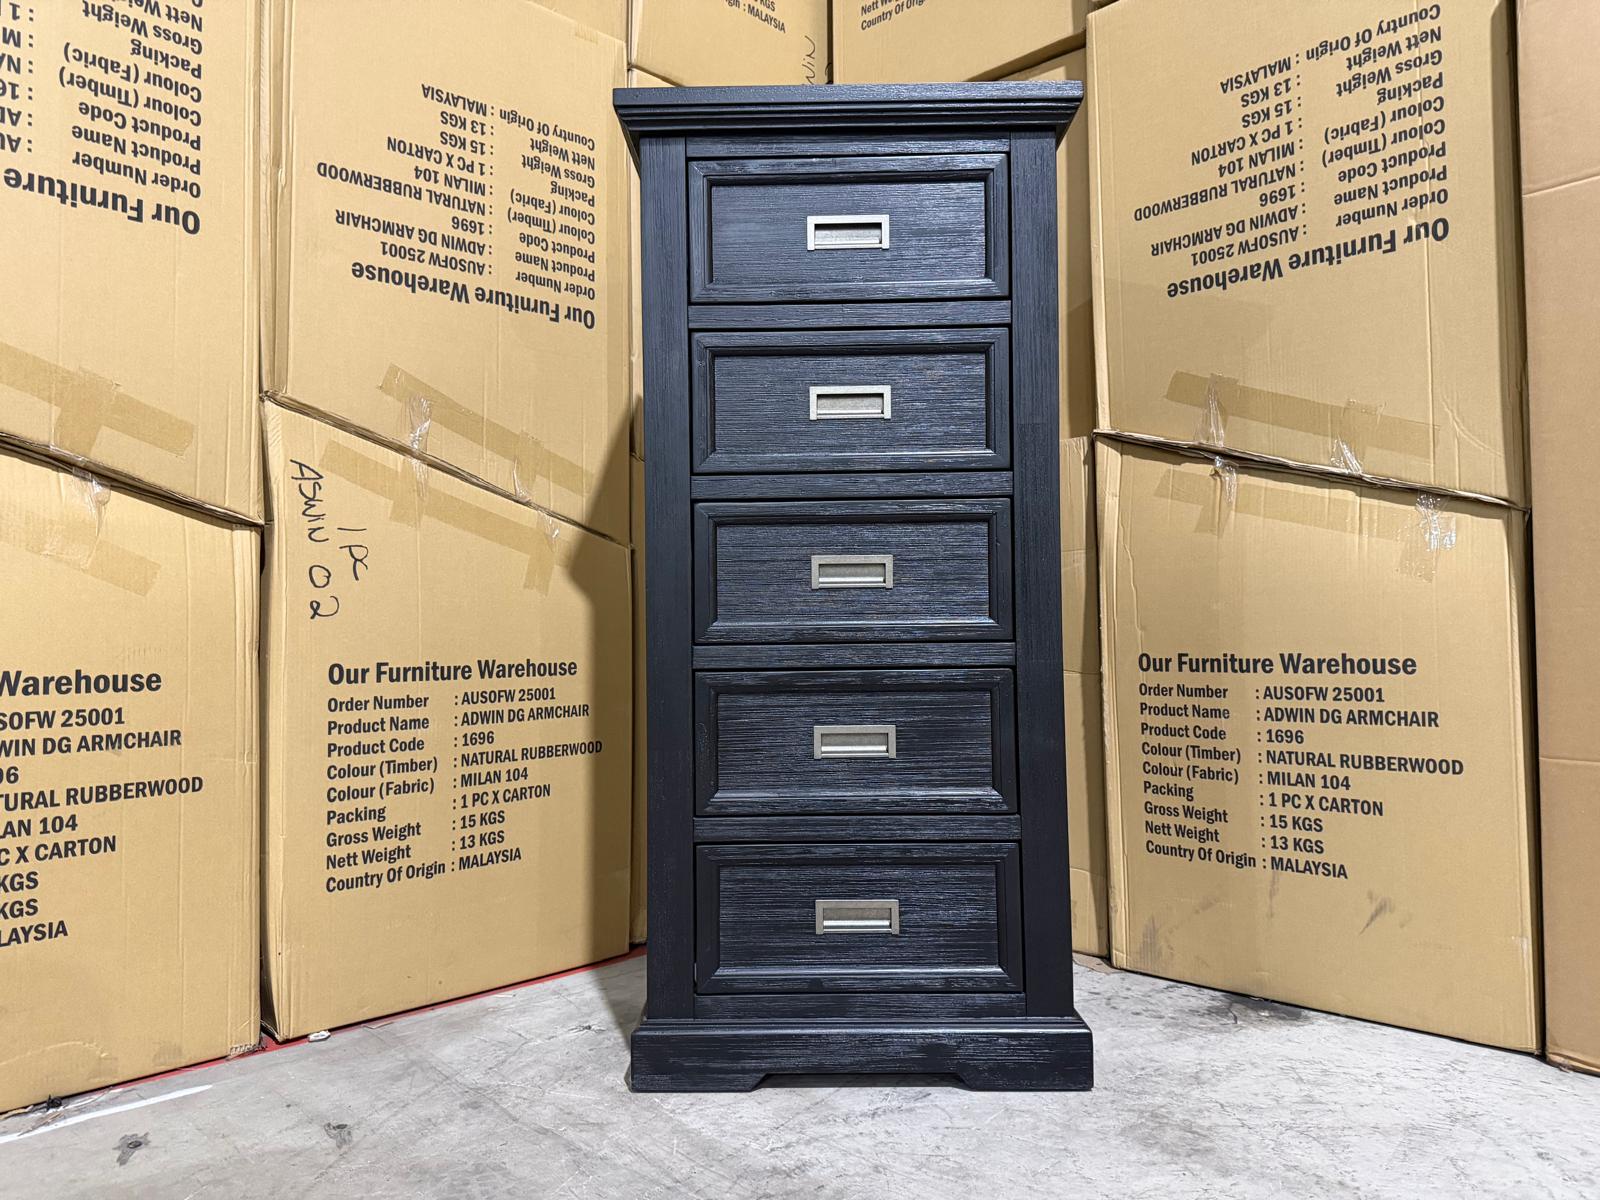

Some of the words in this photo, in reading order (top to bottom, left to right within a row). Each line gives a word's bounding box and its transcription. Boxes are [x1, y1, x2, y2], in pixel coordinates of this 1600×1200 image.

[82, 0, 149, 39] Weight
[164, 4, 203, 33] Nett
[746, 3, 786, 34] MALAYSIA
[860, 8, 893, 31] Country
[152, 24, 203, 56] Gross
[63, 41, 140, 85] (Fabric)
[129, 38, 202, 80] Packing
[58, 65, 140, 109] (Timber)
[143, 71, 202, 104] Colour
[78, 101, 127, 130] Code
[143, 95, 202, 127] Colour
[1389, 95, 1445, 123] Colour
[71, 125, 127, 156] Name
[131, 116, 201, 152] Product
[1324, 110, 1386, 145] (Fabric)
[1390, 118, 1446, 145] Colour
[130, 140, 201, 176] Product
[1248, 141, 1295, 169] MILAN
[1321, 132, 1387, 169] (Timber)
[1380, 140, 1447, 174] Product
[71, 151, 147, 186] Number
[316, 161, 423, 201] RUBBERWOOD
[413, 165, 440, 185] 104
[1217, 156, 1245, 178] 104
[1230, 162, 1296, 194] NATURAL
[1337, 162, 1378, 184] Code
[1381, 164, 1448, 196] Product
[3, 167, 144, 224] Furniture
[151, 172, 201, 199] Order
[443, 172, 486, 197] MILAN
[1258, 184, 1296, 208] 1696
[1333, 183, 1379, 206] Name
[425, 188, 486, 217] NATURAL
[510, 188, 557, 216] (Fabric)
[558, 204, 596, 226] Colour
[1133, 182, 1228, 222] RUBBERWOOD
[1335, 200, 1398, 228] Number
[1401, 188, 1449, 218] Order
[151, 202, 201, 235] Our
[335, 209, 416, 240] ARMCHAIR
[451, 215, 485, 236] 1696
[507, 206, 557, 235] (Timber)
[1225, 219, 1246, 237] DG
[1249, 204, 1299, 232] ADWIN
[1403, 217, 1450, 248] Our
[417, 227, 438, 247] DG
[441, 233, 486, 257] ADWIN
[518, 232, 549, 253] Code
[558, 223, 596, 245] Colour
[1150, 224, 1223, 257] ARMCHAIR
[1237, 225, 1300, 256] AUSOFW
[380, 240, 426, 264] 25001
[428, 251, 486, 277] AUSOFW
[514, 251, 549, 272] Name
[551, 240, 595, 264] Product
[1190, 242, 1235, 267] 25001
[1288, 229, 1397, 270] Furniture
[351, 261, 470, 305] Warehouse
[515, 271, 562, 294] Number
[551, 259, 596, 283] Product
[1166, 257, 1284, 298] Warehouse
[474, 286, 560, 324] Furniture
[563, 281, 596, 301] Order
[563, 305, 596, 330] Our
[328, 662, 370, 686] Our
[375, 660, 473, 684] Furniture
[476, 658, 578, 680] Warehouse
[1138, 652, 1173, 673] Our
[1177, 652, 1275, 674] Furniture
[1278, 652, 1417, 676] Warehouse
[327, 696, 371, 713] Order
[373, 693, 430, 711] Number
[460, 688, 516, 706] AUSOFW
[517, 686, 556, 703] 25001
[1138, 682, 1174, 697] Order
[1176, 683, 1229, 699] Number
[1262, 685, 1329, 702] AUSOFW
[1332, 686, 1385, 703] 25001
[60, 706, 126, 728] 25001
[327, 717, 387, 736] Product
[389, 715, 430, 732] Name
[460, 708, 505, 727] ADWIN
[507, 707, 525, 723] DG
[526, 703, 590, 722] ARMCHAIR
[1139, 701, 1190, 718] Product
[1191, 703, 1231, 720] Name
[1263, 706, 1316, 724] ADWIN
[1319, 708, 1343, 725] DG
[1345, 708, 1440, 728] ARMCHAIR
[42, 736, 72, 755] DG
[76, 729, 182, 753] ARMCHAIR
[327, 739, 386, 758] Product
[388, 736, 425, 753] Code
[461, 730, 495, 747] 1696
[1140, 721, 1191, 739] Product
[1192, 724, 1227, 741] Code
[1266, 728, 1305, 745] 1696
[326, 763, 377, 781] Colour
[379, 756, 438, 779] (Timber)
[460, 748, 519, 768] NATURAL
[520, 740, 603, 761] RUBBERWOOD
[1141, 741, 1183, 758] Colour
[1185, 744, 1242, 765] (Timber)
[1266, 749, 1337, 768] NATURAL
[1339, 753, 1464, 776] RUBBERWOOD
[326, 785, 377, 803] Colour
[378, 777, 435, 801] (Fabric)
[460, 769, 502, 788] MILAN
[505, 766, 529, 783] 104
[1142, 760, 1184, 778] Colour
[1186, 764, 1239, 786] (Fabric)
[1267, 770, 1316, 789] MILAN
[1320, 774, 1352, 791] 104
[65, 776, 204, 807] RUBBERWOOD
[326, 805, 387, 826] Packing
[471, 791, 490, 808] PC
[502, 783, 551, 804] CARTON
[1143, 780, 1195, 803] Packing
[1281, 792, 1302, 810] PC
[1318, 795, 1384, 817] CARTON
[39, 813, 79, 835] 104
[326, 831, 369, 848] Gross
[371, 821, 422, 842] Weight
[460, 813, 477, 830] 15
[479, 809, 506, 827] KGS
[1143, 800, 1180, 818] Gross
[1181, 804, 1229, 825] Weight
[1269, 813, 1289, 830] 15
[1291, 815, 1324, 833] KGS
[34, 834, 117, 862] CARTON
[326, 851, 359, 871] Nett
[361, 844, 412, 865] Weight
[459, 834, 476, 850] 13
[479, 829, 505, 847] KGS
[1144, 819, 1173, 837] Nett
[1173, 823, 1221, 844] Weight
[1270, 834, 1289, 851] 13
[1292, 837, 1325, 855] KGS
[325, 871, 384, 893] Country
[386, 865, 404, 884] Of
[405, 860, 446, 880] Origin
[458, 847, 522, 871] MALAYSIA
[1145, 839, 1195, 863] Country
[1197, 846, 1213, 862] Of
[1215, 848, 1257, 870] Origin
[1270, 855, 1349, 880] MALAYSIA
